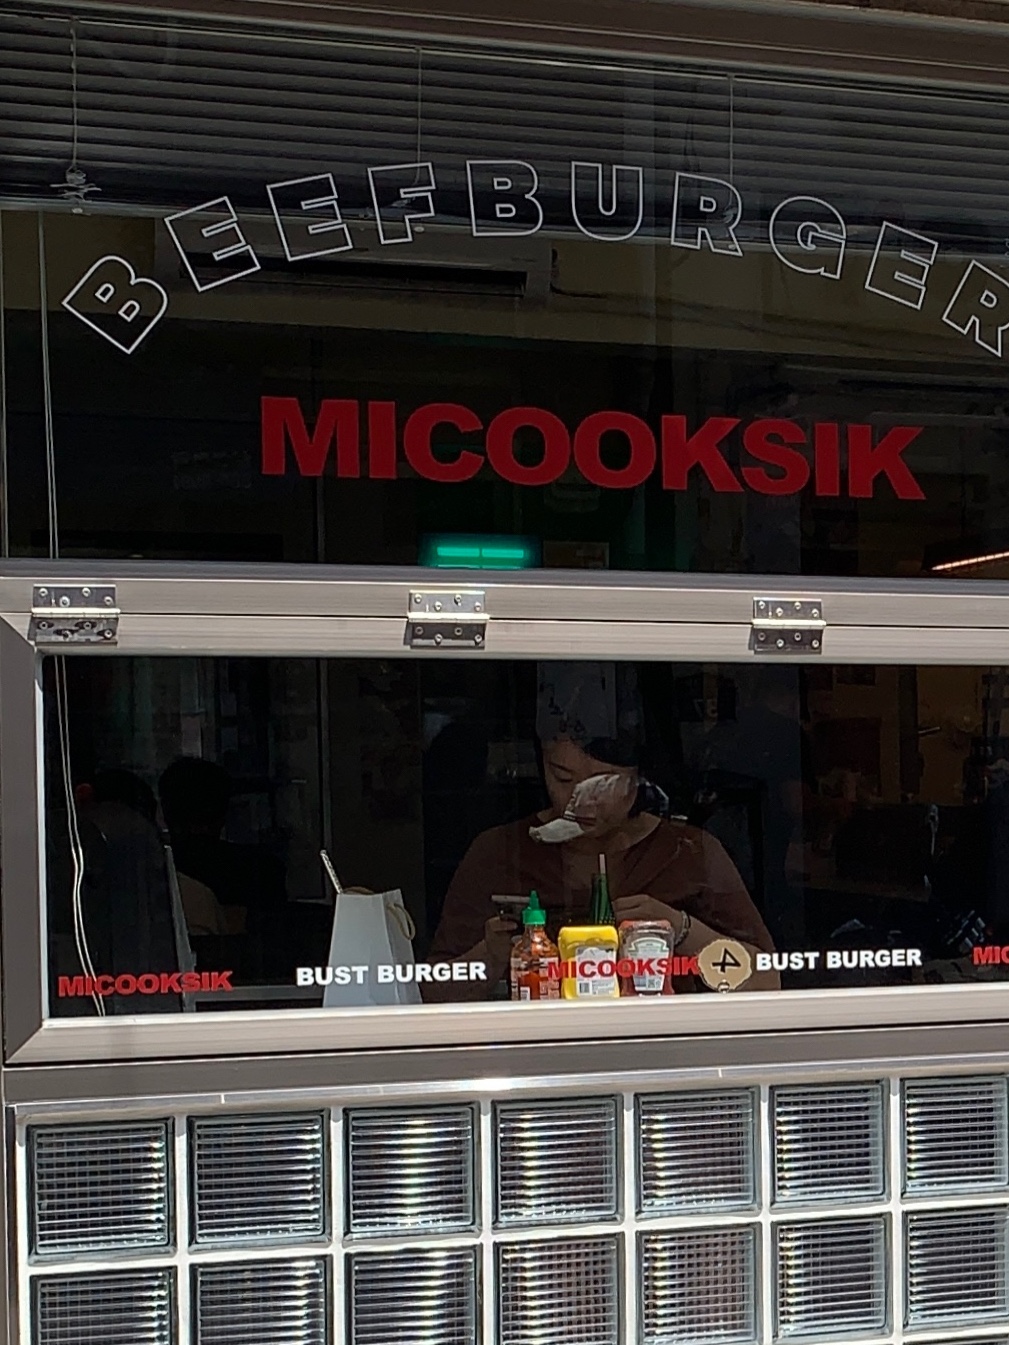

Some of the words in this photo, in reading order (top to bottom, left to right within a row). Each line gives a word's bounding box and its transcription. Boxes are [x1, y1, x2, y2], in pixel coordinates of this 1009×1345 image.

[261, 396, 926, 500] MICOOKSIK
[547, 956, 700, 979] MICOOKSIK
[756, 951, 820, 971] BUST
[826, 948, 922, 969] BURGER
[57, 970, 233, 998] MICOOKSIK
[296, 965, 368, 987] BUST
[377, 961, 487, 984] BURGER
